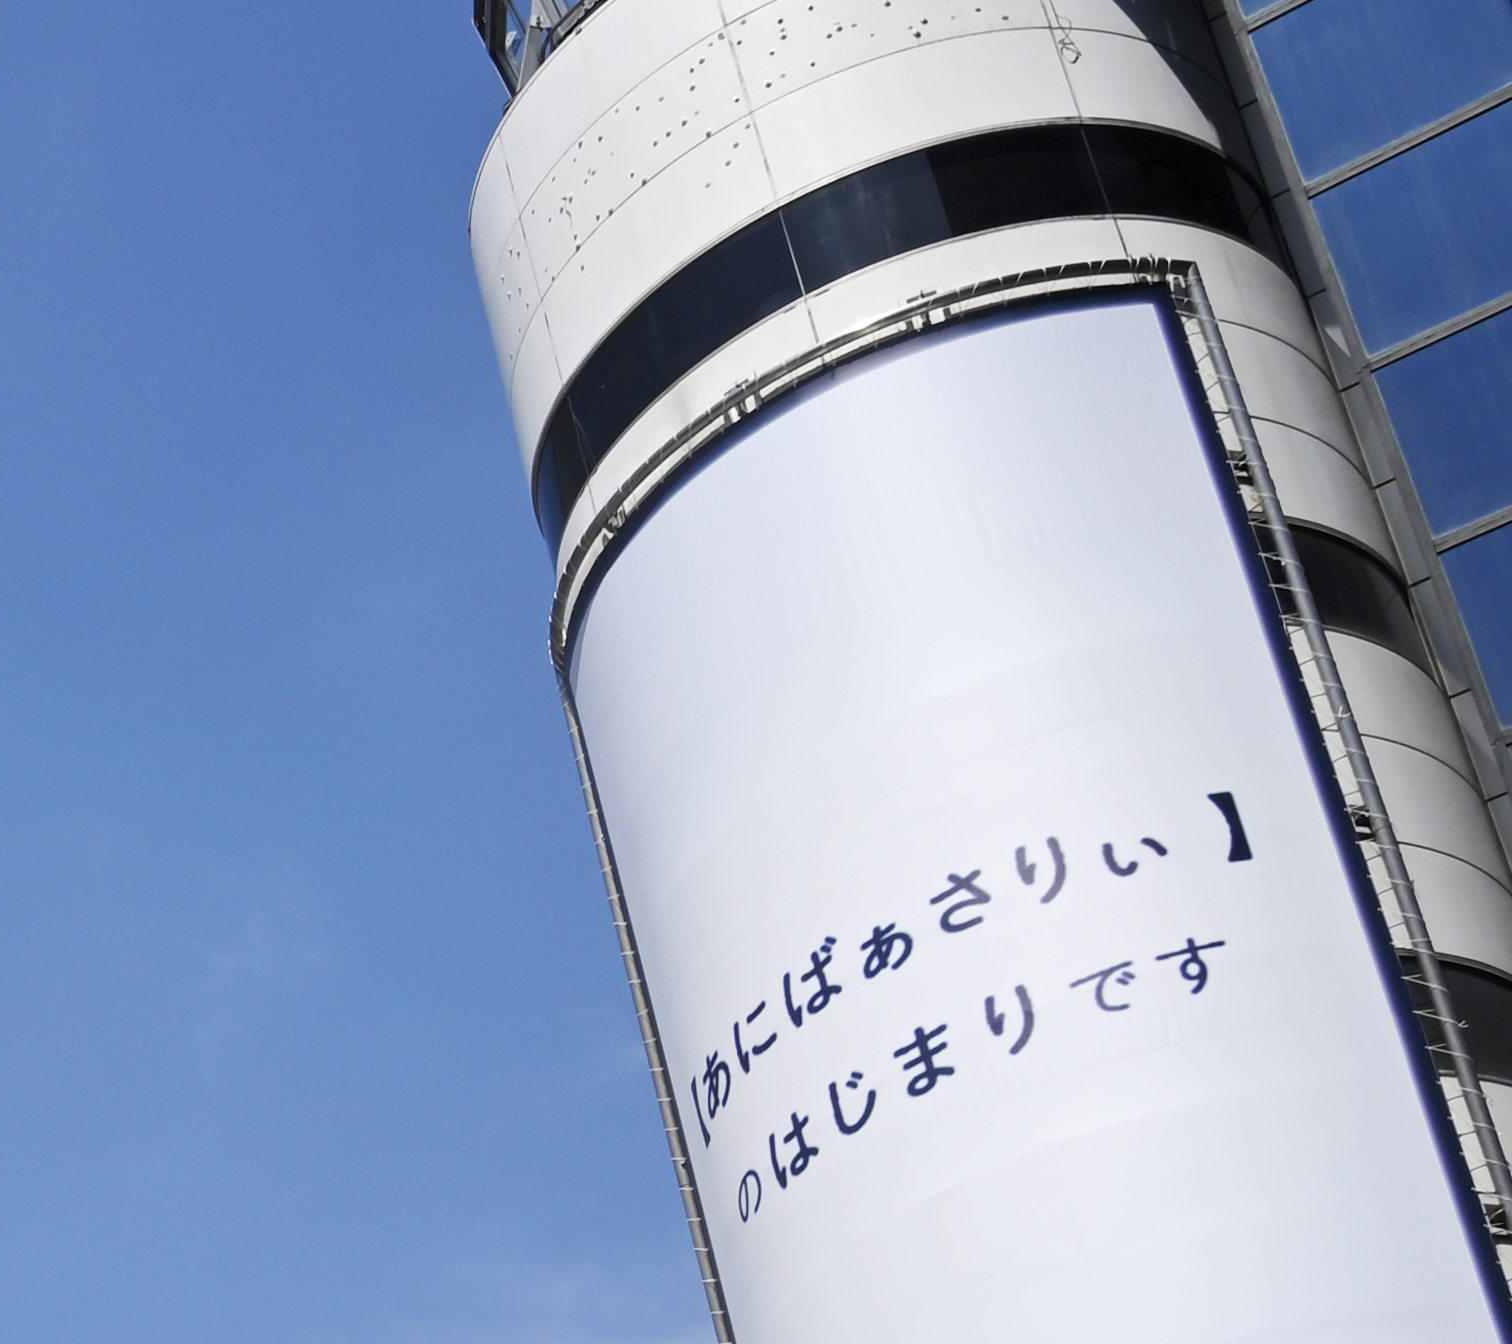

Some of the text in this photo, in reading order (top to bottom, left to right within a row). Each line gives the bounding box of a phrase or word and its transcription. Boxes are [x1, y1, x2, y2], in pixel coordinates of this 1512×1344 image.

[737, 936, 1226, 1222] のはじまりです
